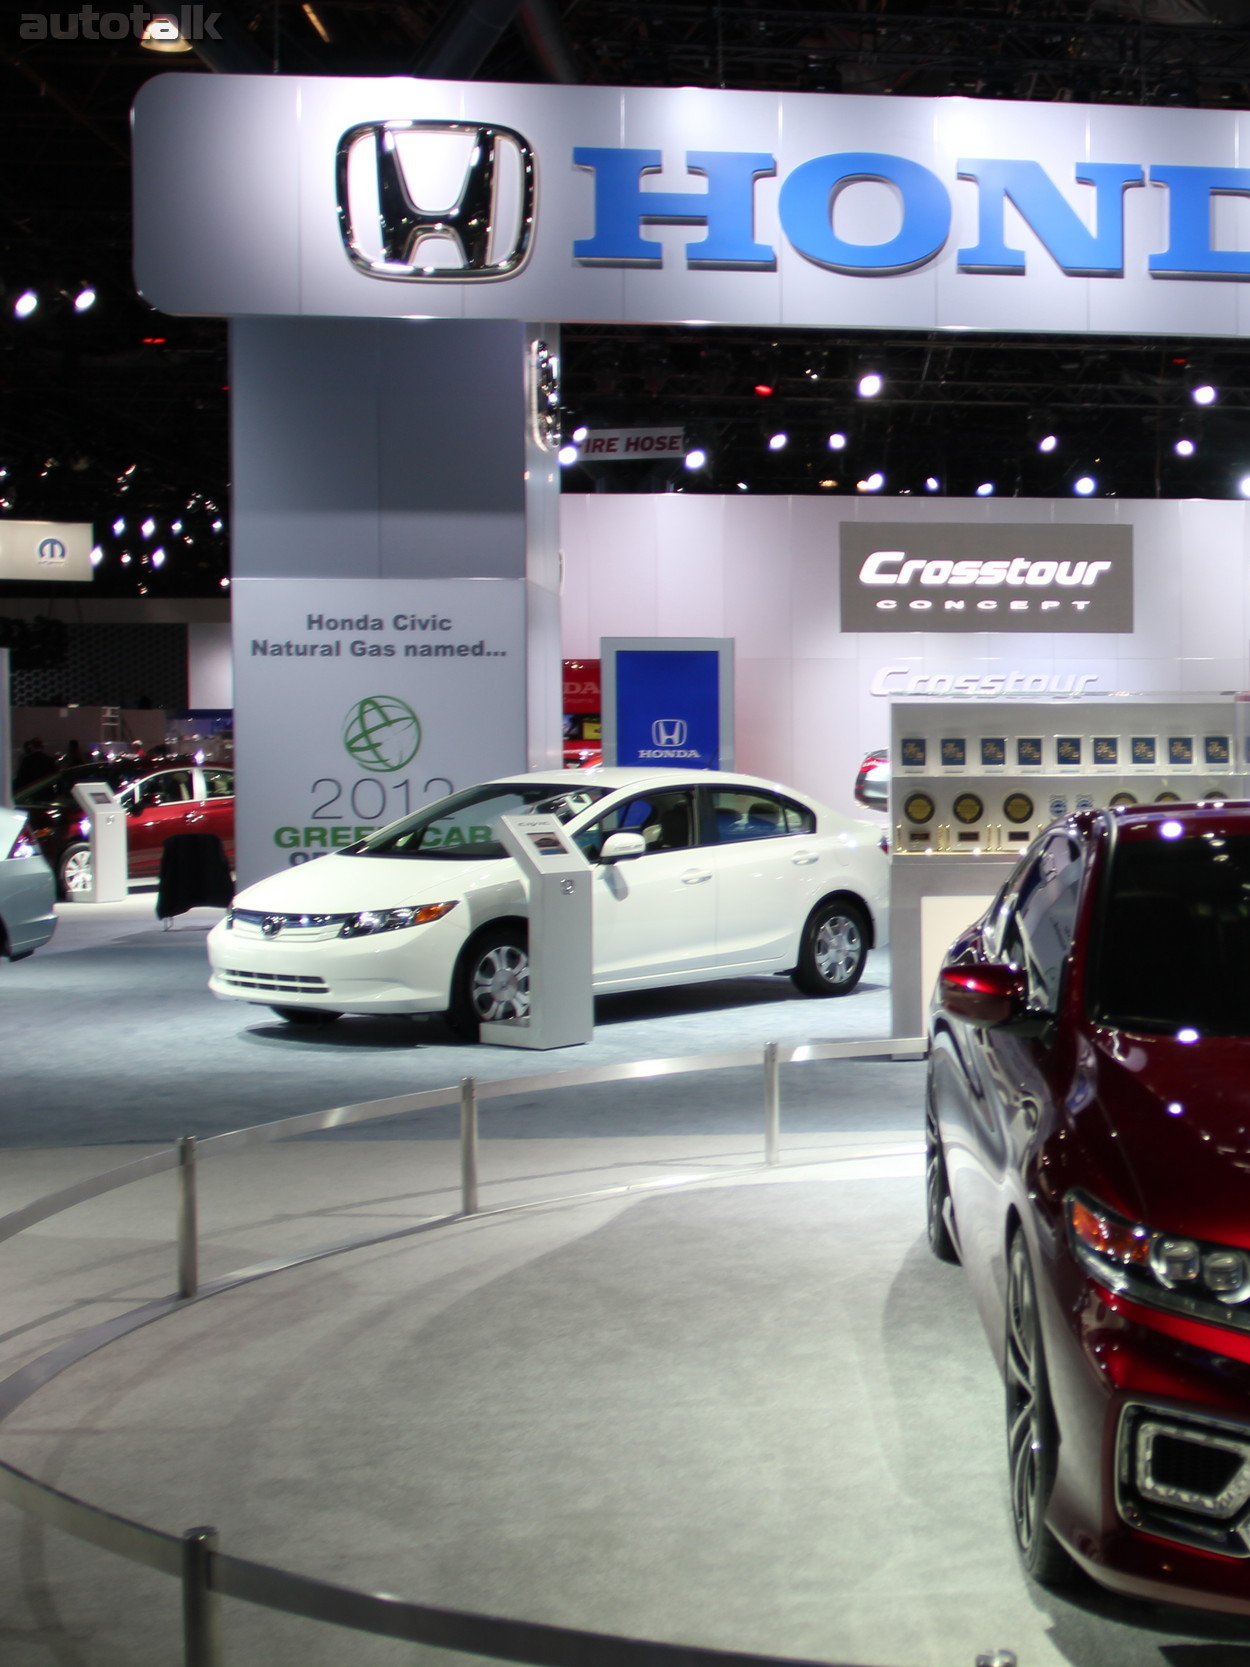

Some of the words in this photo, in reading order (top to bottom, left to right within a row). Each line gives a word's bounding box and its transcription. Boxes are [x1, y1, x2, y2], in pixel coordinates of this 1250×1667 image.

[580, 438, 619, 453] IRE
[626, 435, 682, 452] HOSE
[859, 551, 1112, 585] Crosstour
[876, 599, 1091, 610] CONCEPT
[307, 613, 384, 631] Honda
[392, 613, 452, 631] Civic
[251, 640, 341, 657] Natural
[350, 639, 396, 657] Gas
[404, 640, 507, 657] named...
[870, 667, 1100, 698] Crosstour
[637, 749, 701, 759] HONDA
[310, 777, 455, 820] 2012
